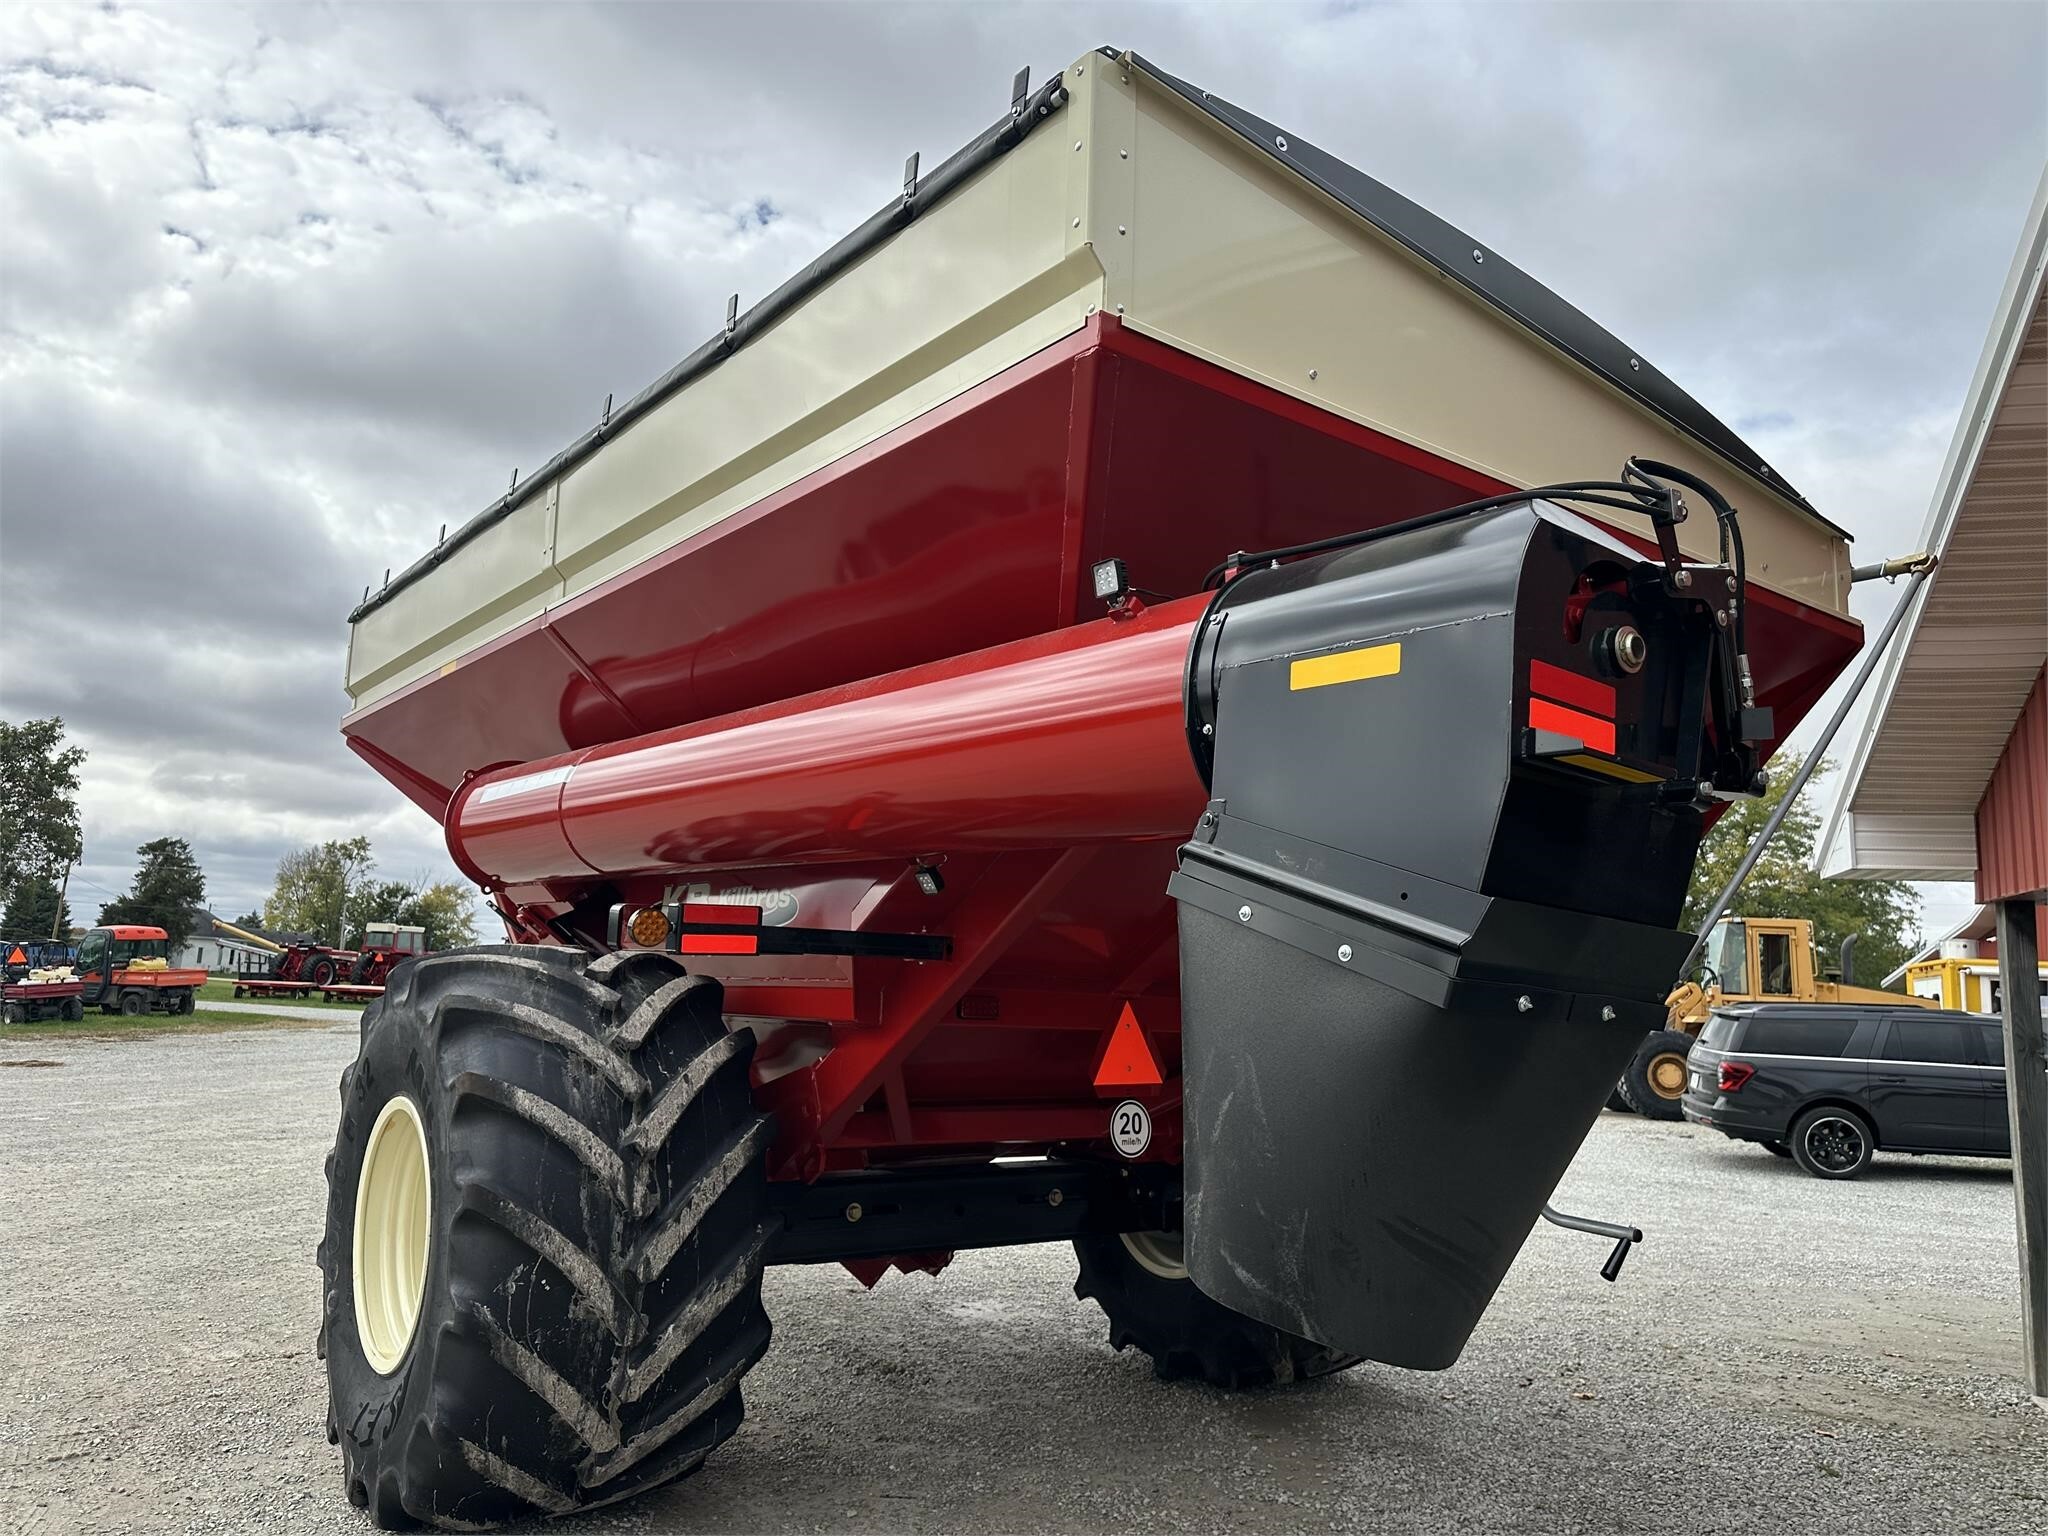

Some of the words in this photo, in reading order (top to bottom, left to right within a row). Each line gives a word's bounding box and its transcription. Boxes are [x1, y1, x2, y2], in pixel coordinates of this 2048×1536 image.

[720, 886, 792, 909] Killbros
[1119, 1112, 1142, 1135] 20
[1121, 1137, 1142, 1146] mile/h
